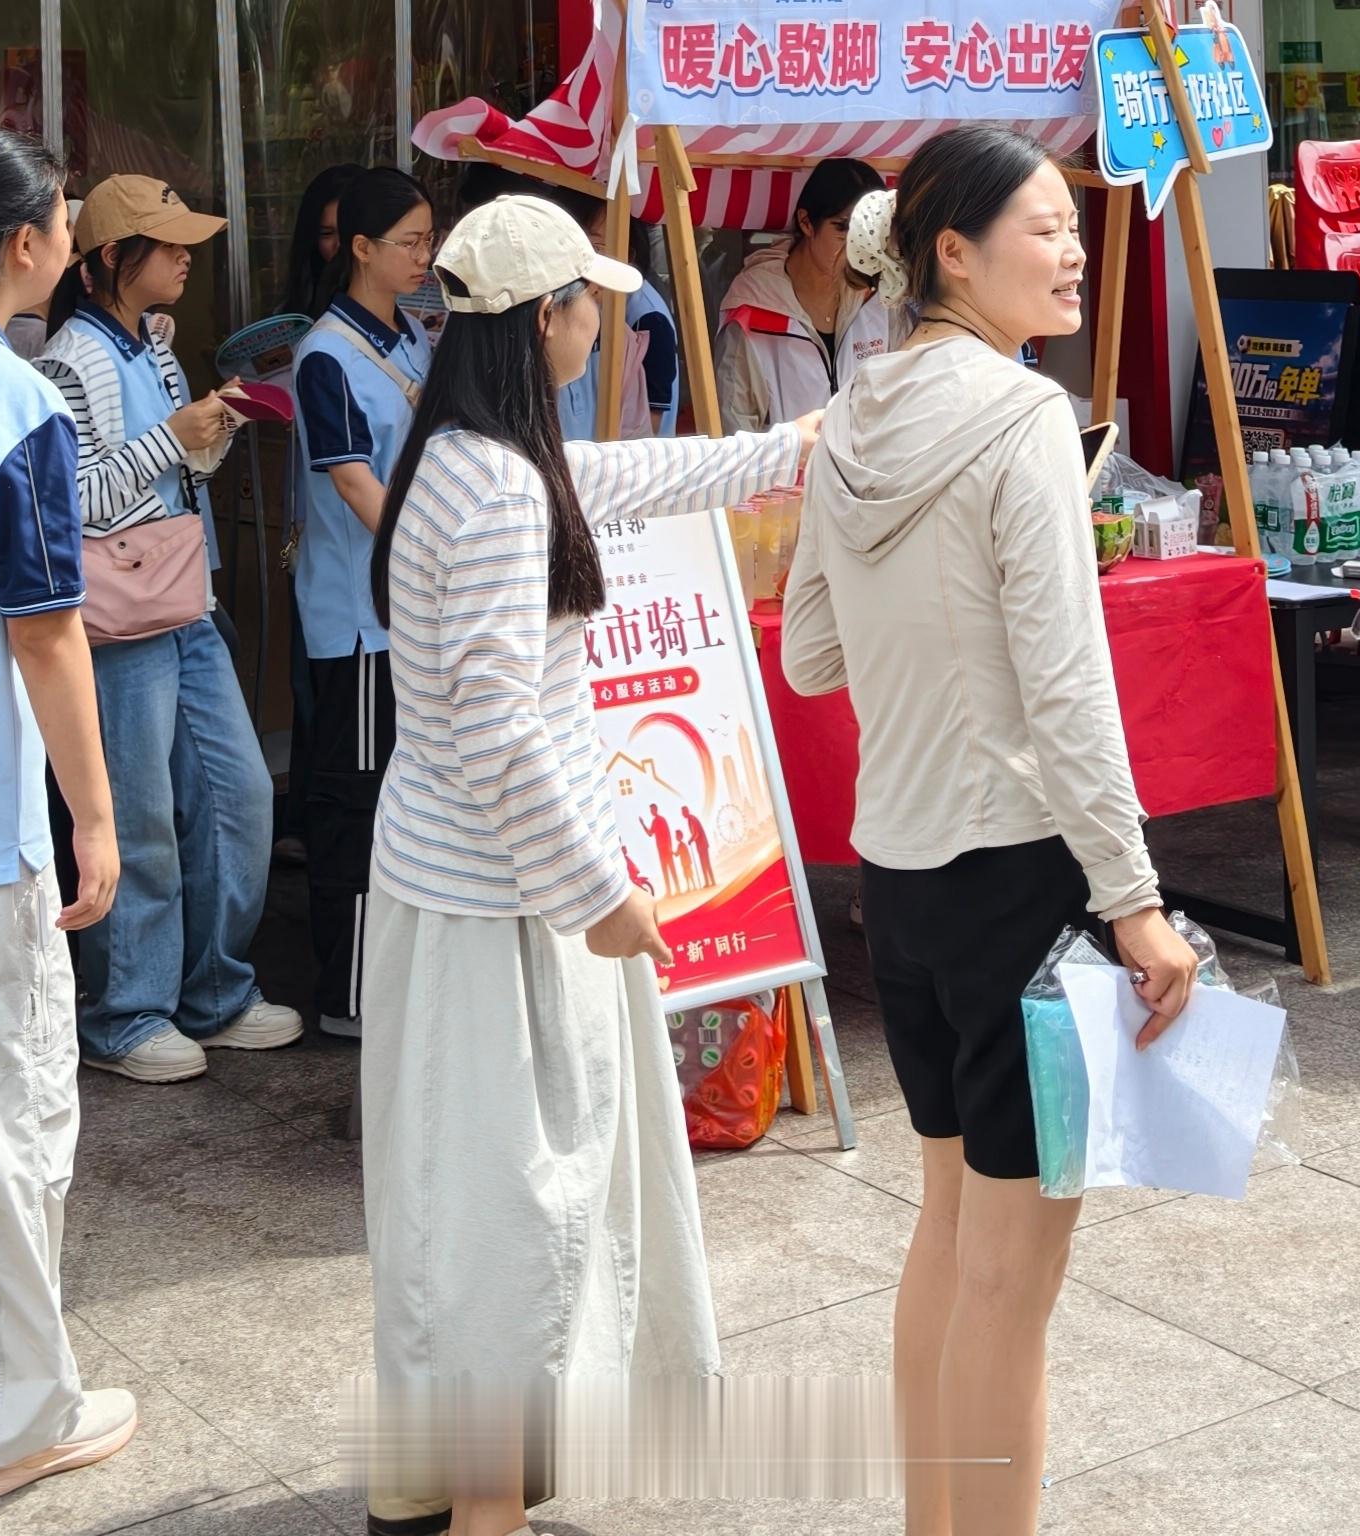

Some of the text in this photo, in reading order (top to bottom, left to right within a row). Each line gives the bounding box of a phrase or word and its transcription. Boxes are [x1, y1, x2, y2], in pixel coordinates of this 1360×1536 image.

[659, 18, 1095, 94] 暖心歇脚 安心出发
[1111, 68, 1251, 129] 骑行好社区
[592, 517, 645, 539] 有邻
[660, 931, 747, 969] “新”同行
